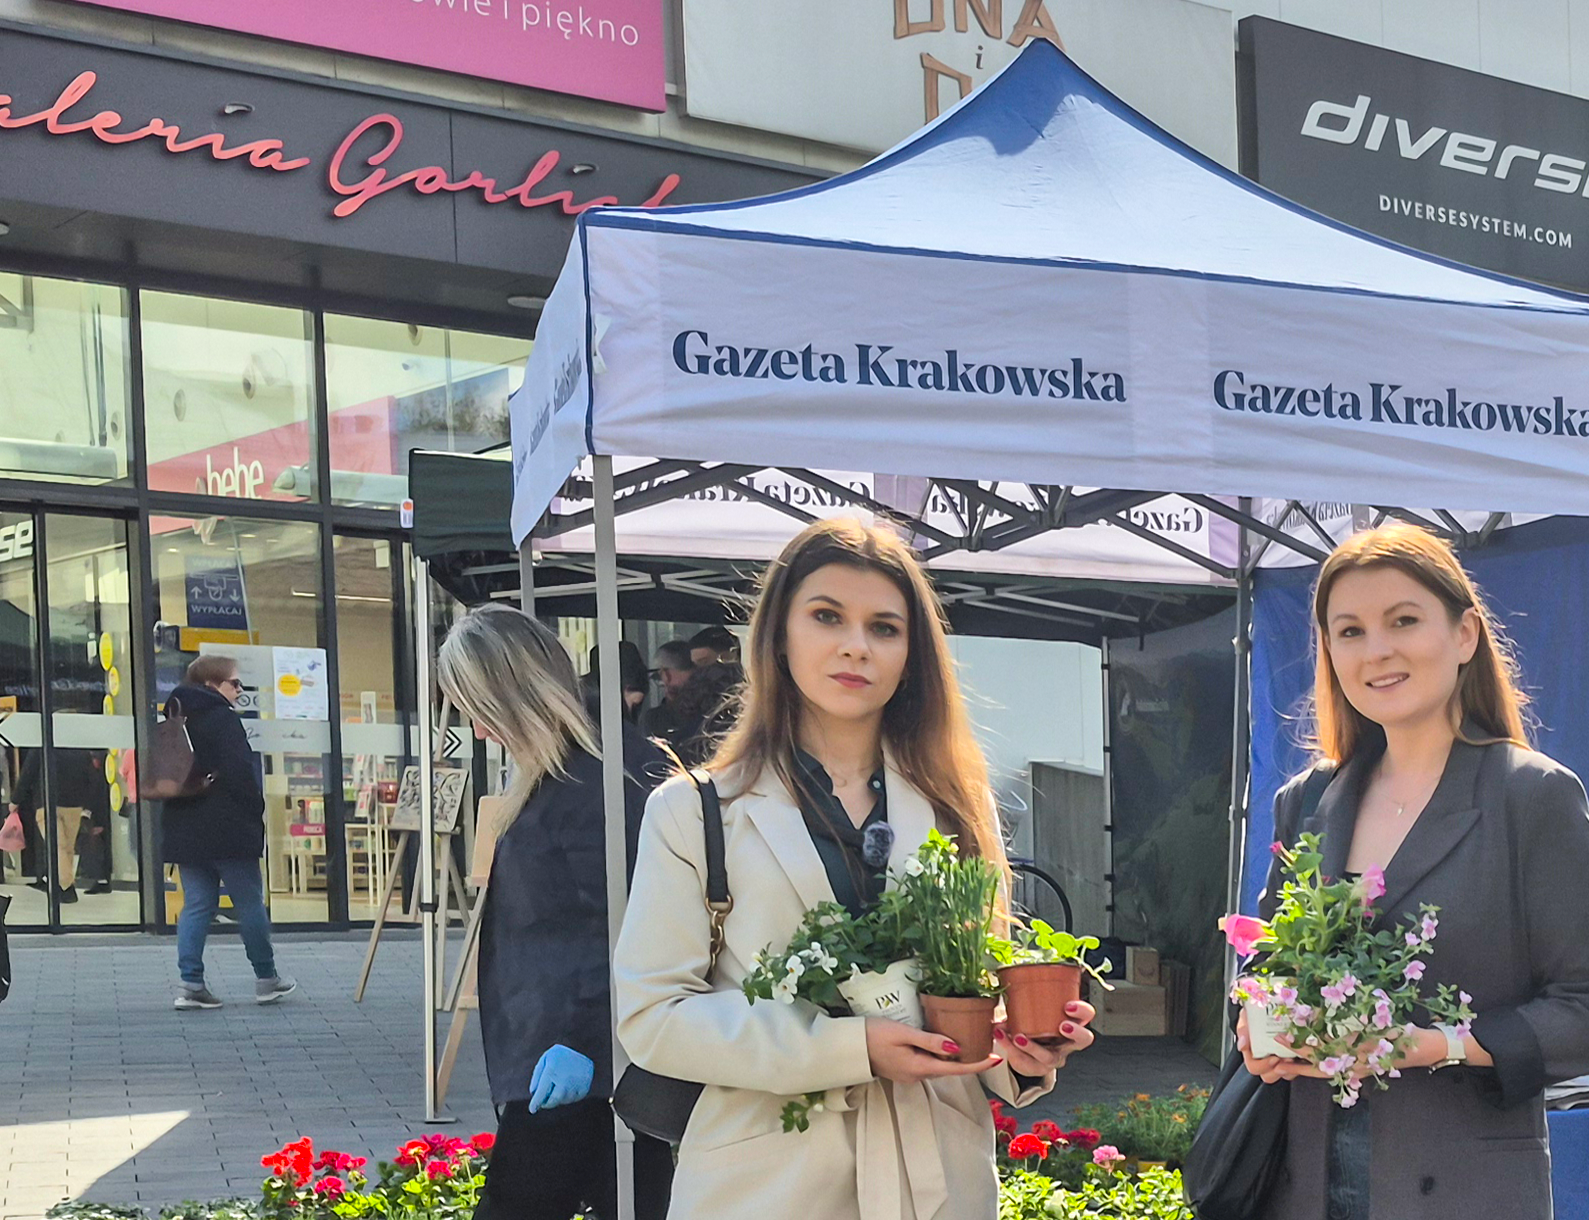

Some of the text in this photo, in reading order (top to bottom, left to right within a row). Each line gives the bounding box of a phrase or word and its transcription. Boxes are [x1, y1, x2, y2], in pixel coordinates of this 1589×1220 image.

[522, 1, 640, 47] piękno
[1379, 194, 1573, 249] DIVERSESYSTEM.COM
[672, 329, 1127, 404] Gazeta Krakowska
[1212, 369, 1362, 422] Gazeta
